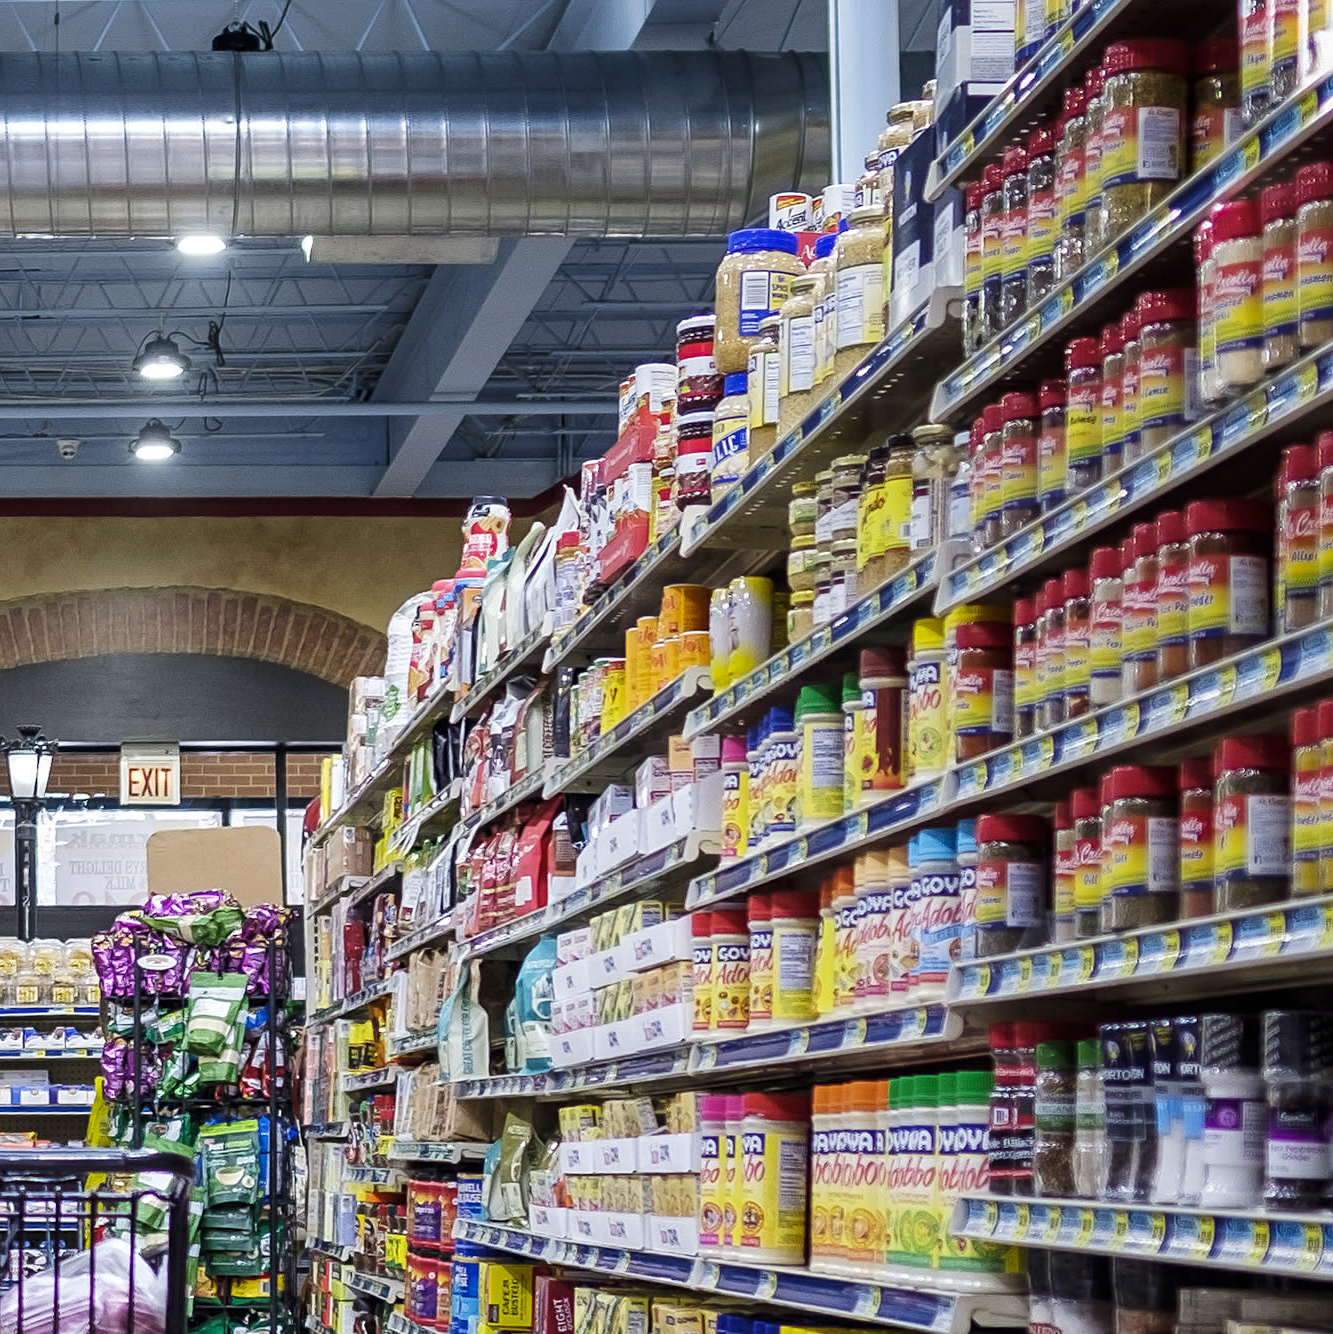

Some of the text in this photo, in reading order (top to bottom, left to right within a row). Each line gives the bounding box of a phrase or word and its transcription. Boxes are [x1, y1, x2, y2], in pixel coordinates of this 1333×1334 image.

[776, 211, 807, 231] Accent
[128, 768, 173, 798] EXIT
[553, 1299, 568, 1333] EIGHT
